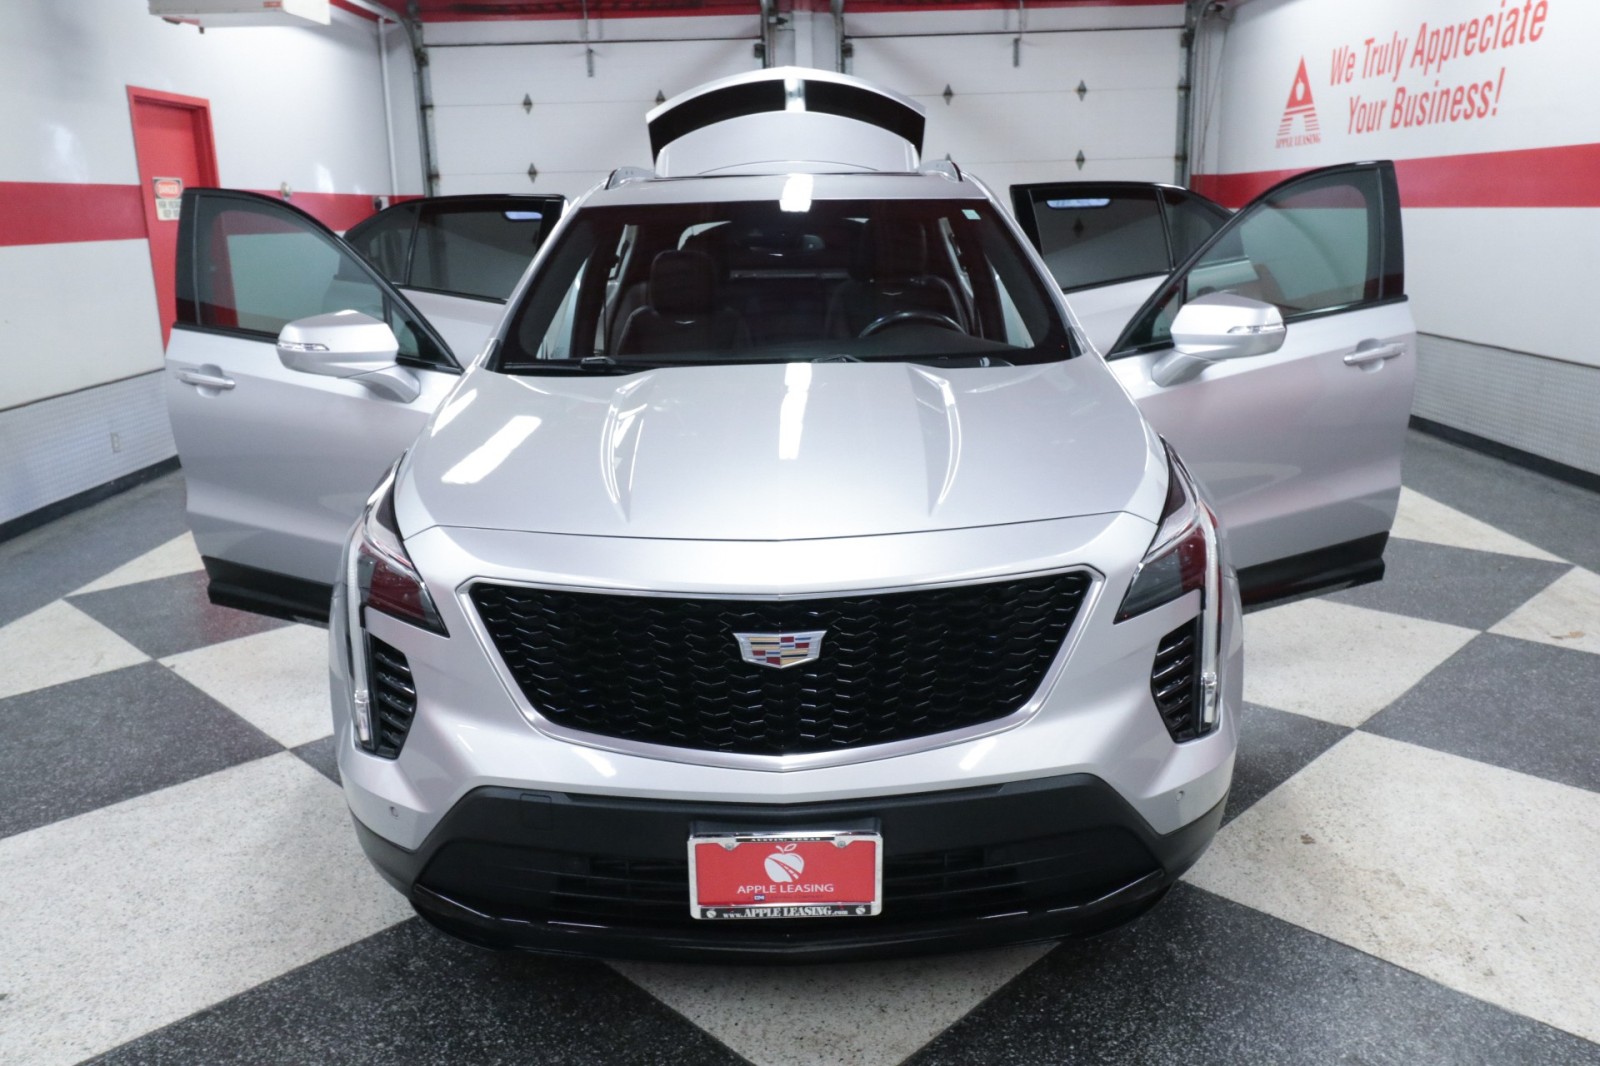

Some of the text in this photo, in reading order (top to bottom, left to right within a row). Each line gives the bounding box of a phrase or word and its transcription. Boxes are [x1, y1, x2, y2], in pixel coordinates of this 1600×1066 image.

[1329, 0, 1549, 87] We Truly Appreciate
[1347, 66, 1506, 136] Your Business!
[736, 883, 834, 894] APPLE LEASING
